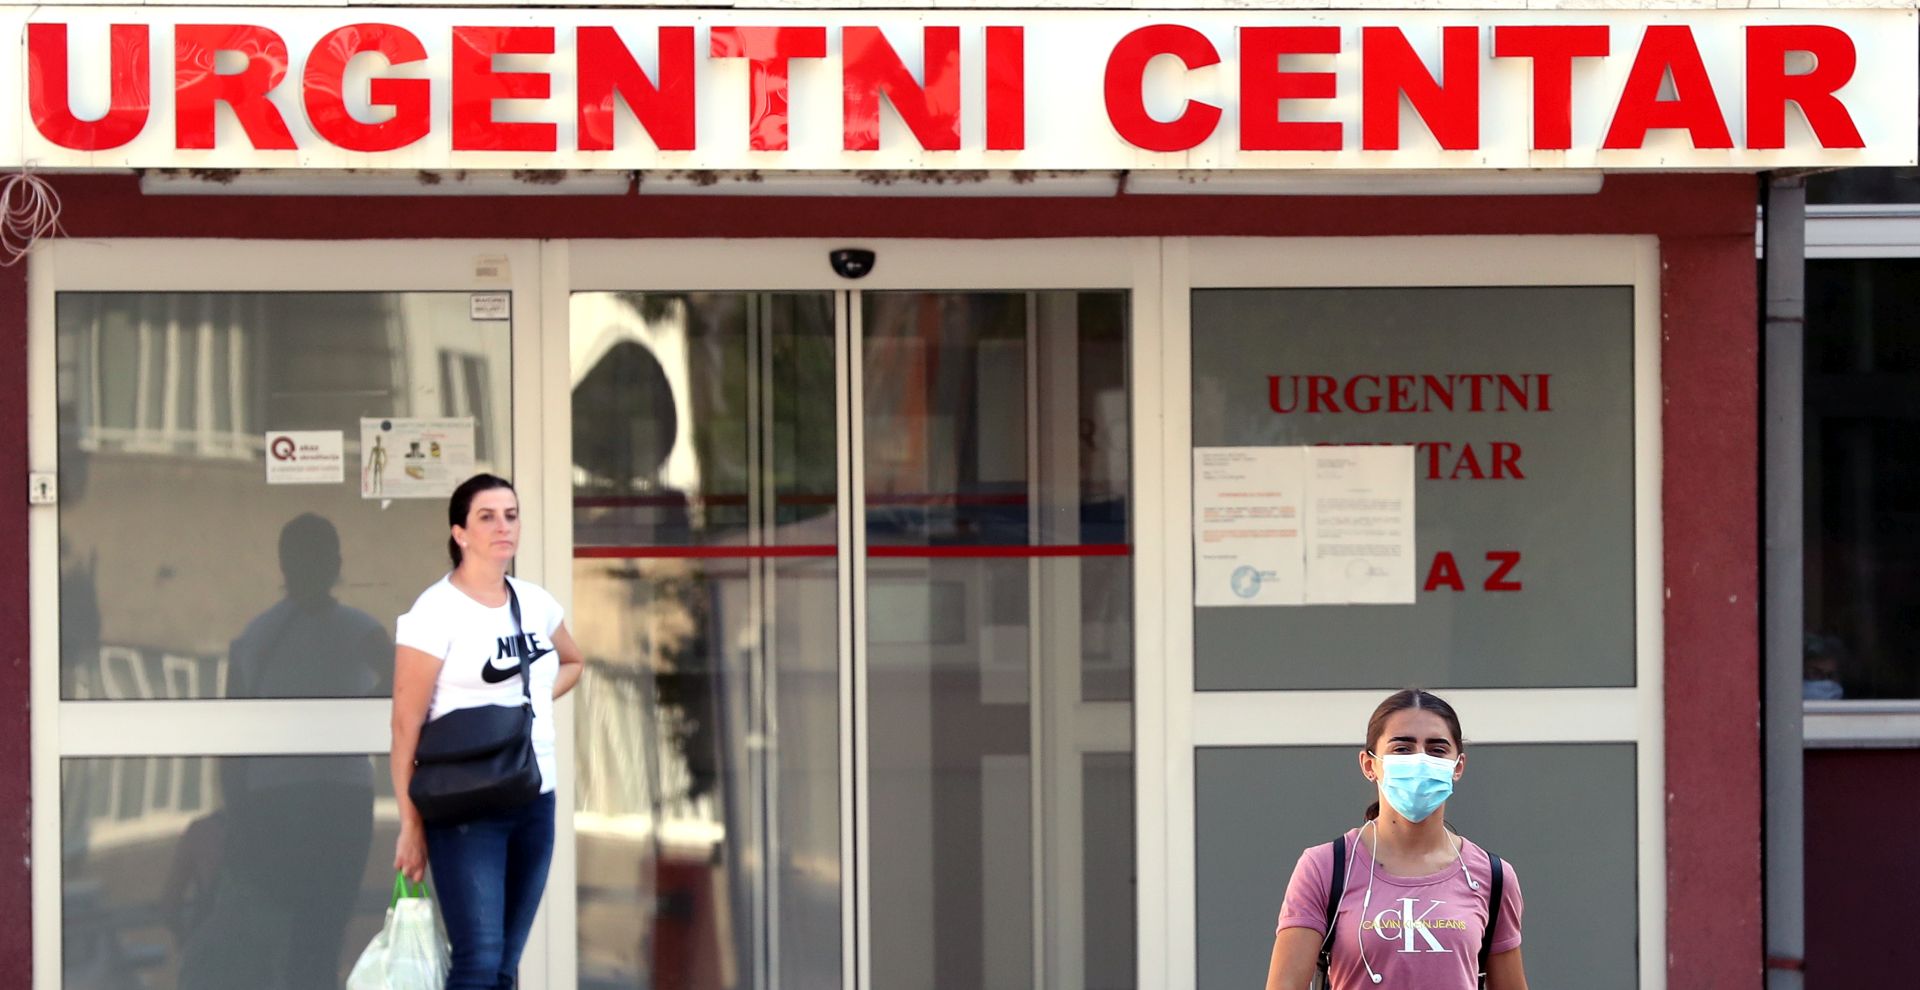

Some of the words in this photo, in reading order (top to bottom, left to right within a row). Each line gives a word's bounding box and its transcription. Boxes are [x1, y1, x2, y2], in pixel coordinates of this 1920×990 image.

[27, 23, 1025, 153] URGENTNI
[1104, 23, 1866, 153] CENTAR
[1266, 373, 1553, 414] URGENTNI
[1433, 919, 1466, 931] JEANS
